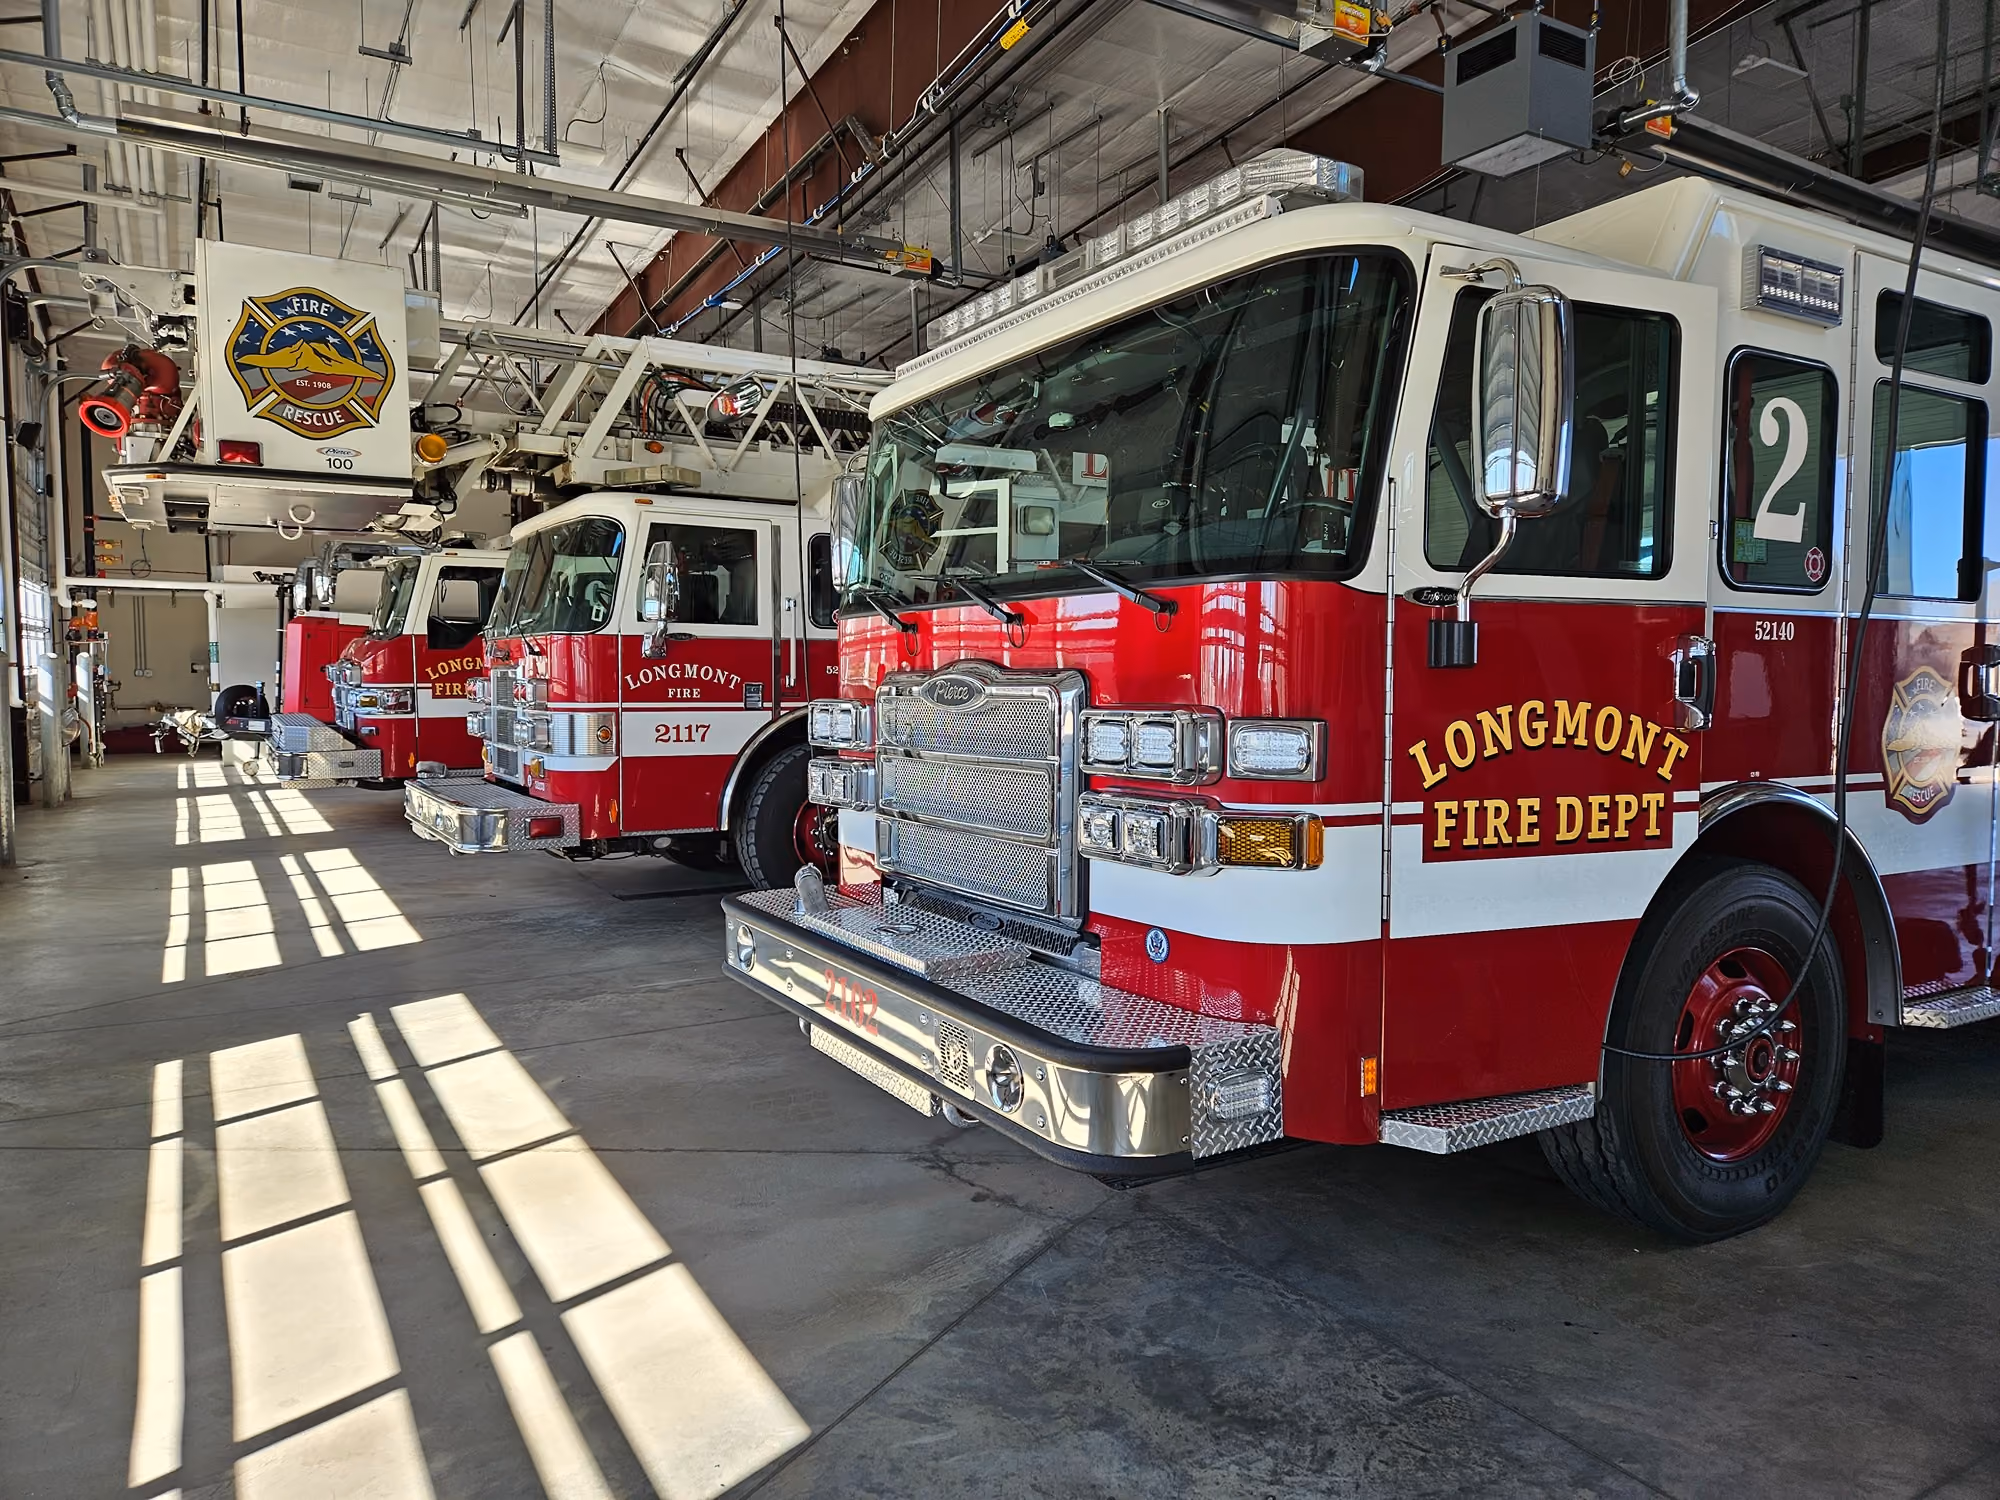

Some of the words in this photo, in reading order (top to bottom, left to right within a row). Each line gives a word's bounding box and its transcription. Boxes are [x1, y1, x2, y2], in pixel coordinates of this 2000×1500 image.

[292, 298, 330, 316] FIRE
[296, 379, 310, 388] EST.
[313, 381, 332, 390] 1908
[282, 404, 345, 426] RESCUE
[325, 457, 353, 470] 100
[1753, 397, 1808, 543] 2
[1754, 620, 1795, 641] 52140
[624, 663, 741, 690] LONGMONT
[1916, 677, 1935, 692] FIRE
[434, 682, 468, 696] FIR
[667, 687, 701, 699] FIRE
[933, 679, 970, 702] Pierce
[655, 723, 711, 743] 2117
[1408, 700, 1689, 790] LONGMONT
[1433, 797, 1541, 849] FIRE
[1555, 793, 1665, 843] DEPT
[824, 968, 879, 1038] 2102
